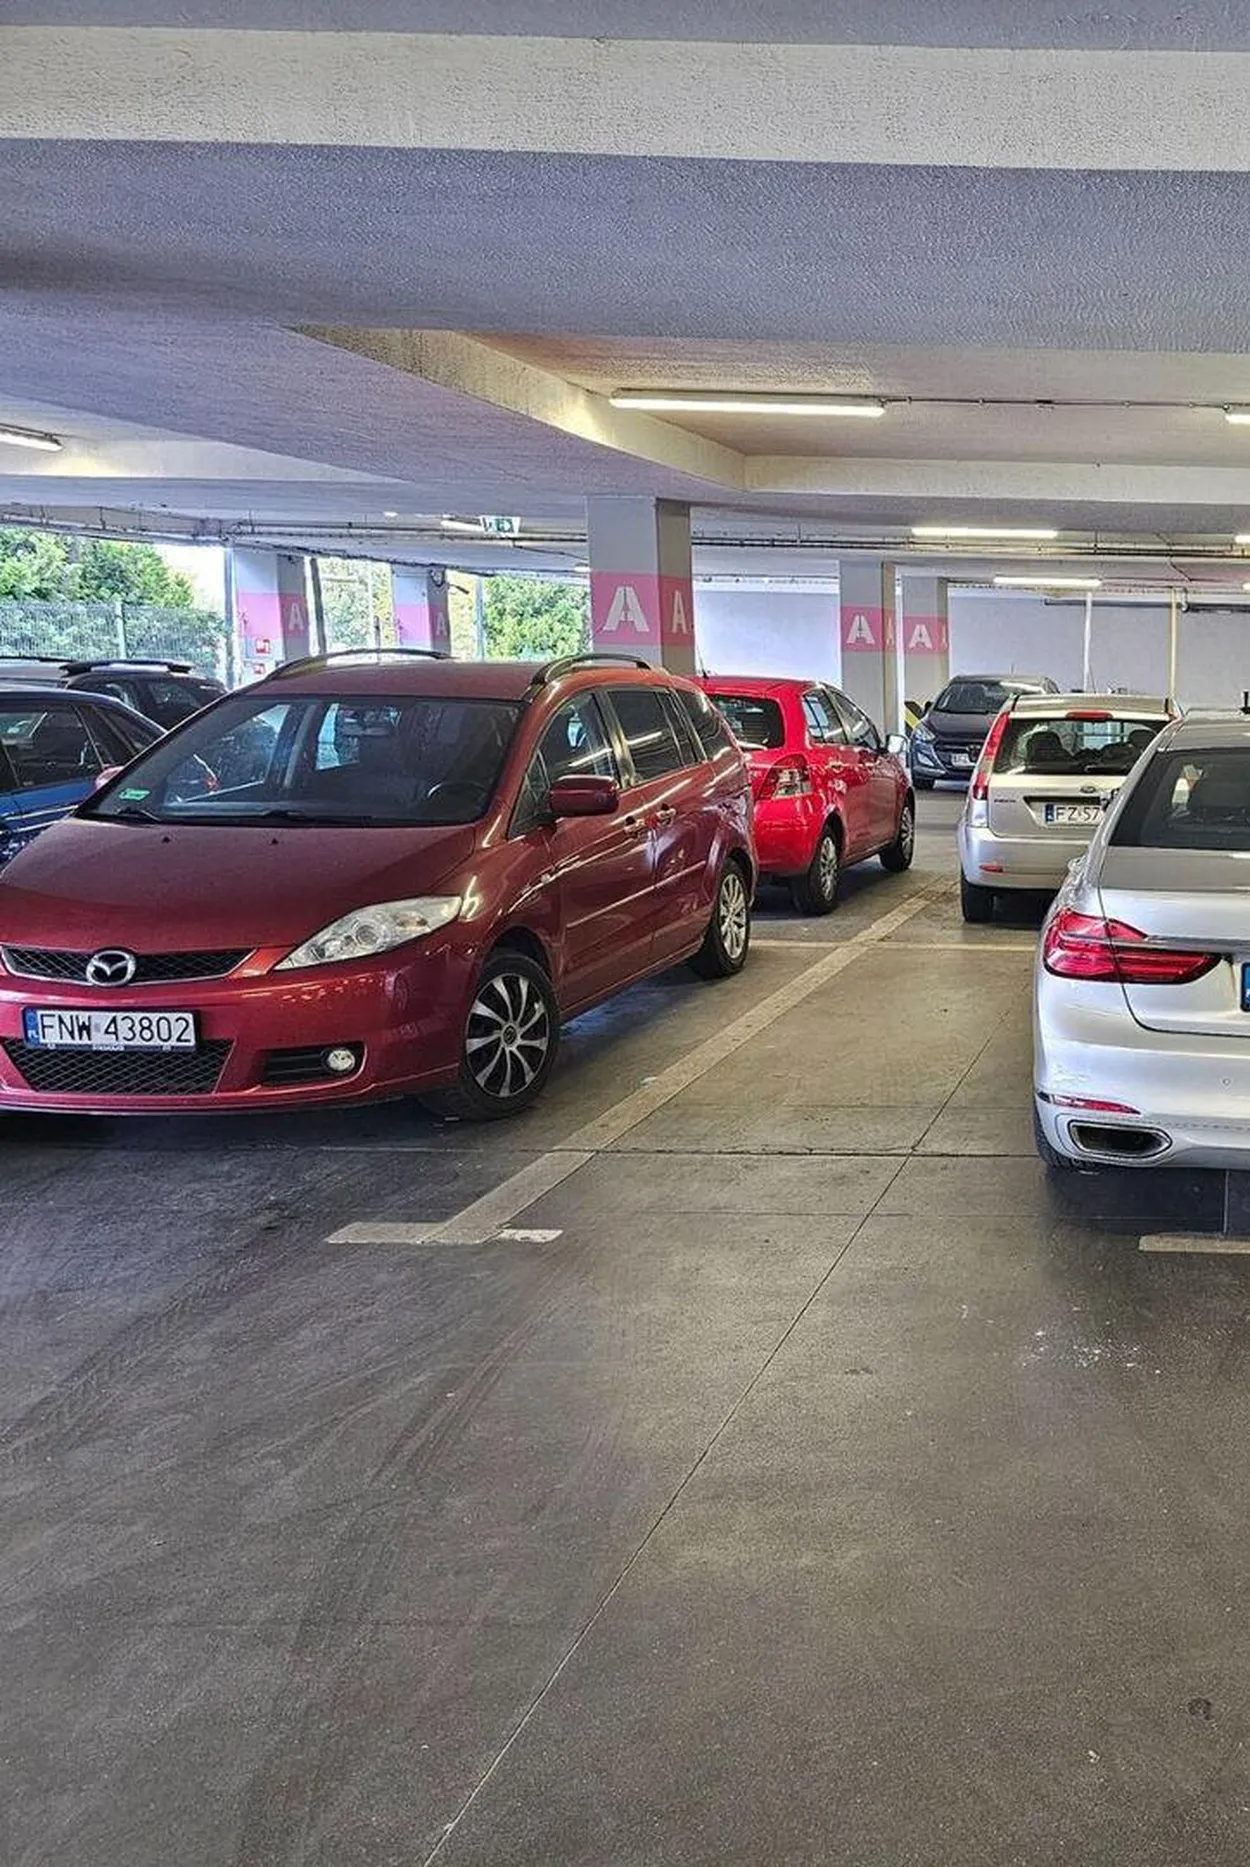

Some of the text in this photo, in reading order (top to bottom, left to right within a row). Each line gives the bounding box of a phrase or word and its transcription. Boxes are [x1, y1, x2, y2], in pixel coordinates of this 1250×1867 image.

[288, 603, 304, 630] A
[603, 586, 649, 632] A
[671, 590, 688, 634] A
[435, 612, 448, 636] A
[846, 615, 876, 644] A
[908, 624, 933, 649] A
[1056, 806, 1078, 821] FZ
[40, 1013, 191, 1043] FNW 43802
